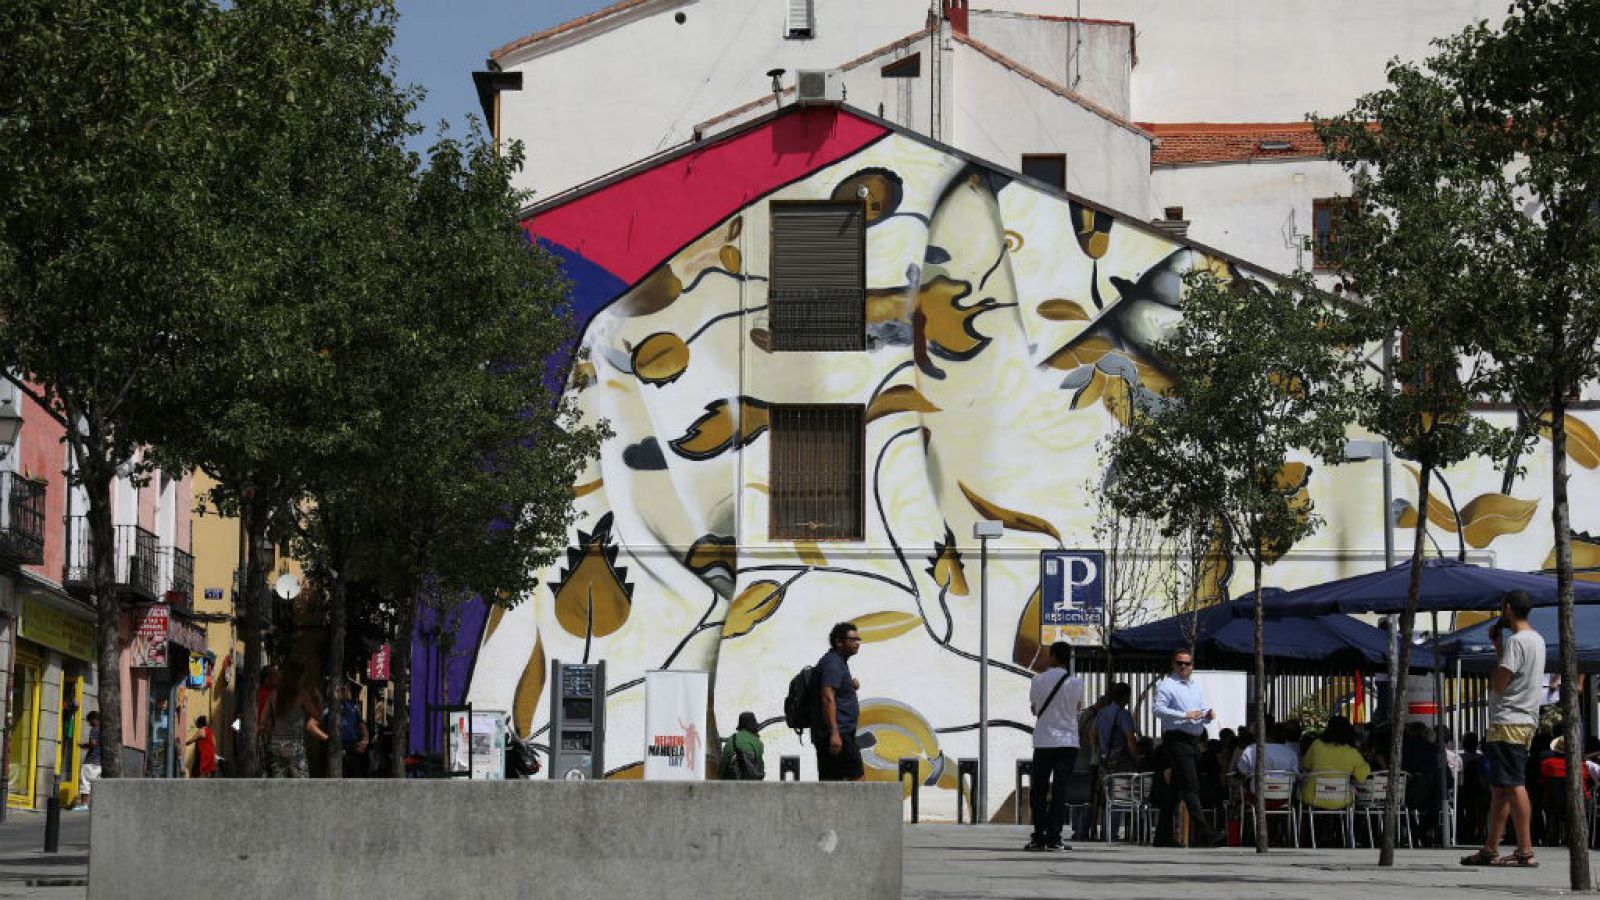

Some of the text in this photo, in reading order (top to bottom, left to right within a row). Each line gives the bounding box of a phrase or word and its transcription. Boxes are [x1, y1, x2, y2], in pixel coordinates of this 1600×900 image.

[1056, 556, 1097, 610] P
[655, 735, 684, 746] NELSON
[648, 745, 684, 757] MANDELA
[669, 756, 683, 767] DAY
